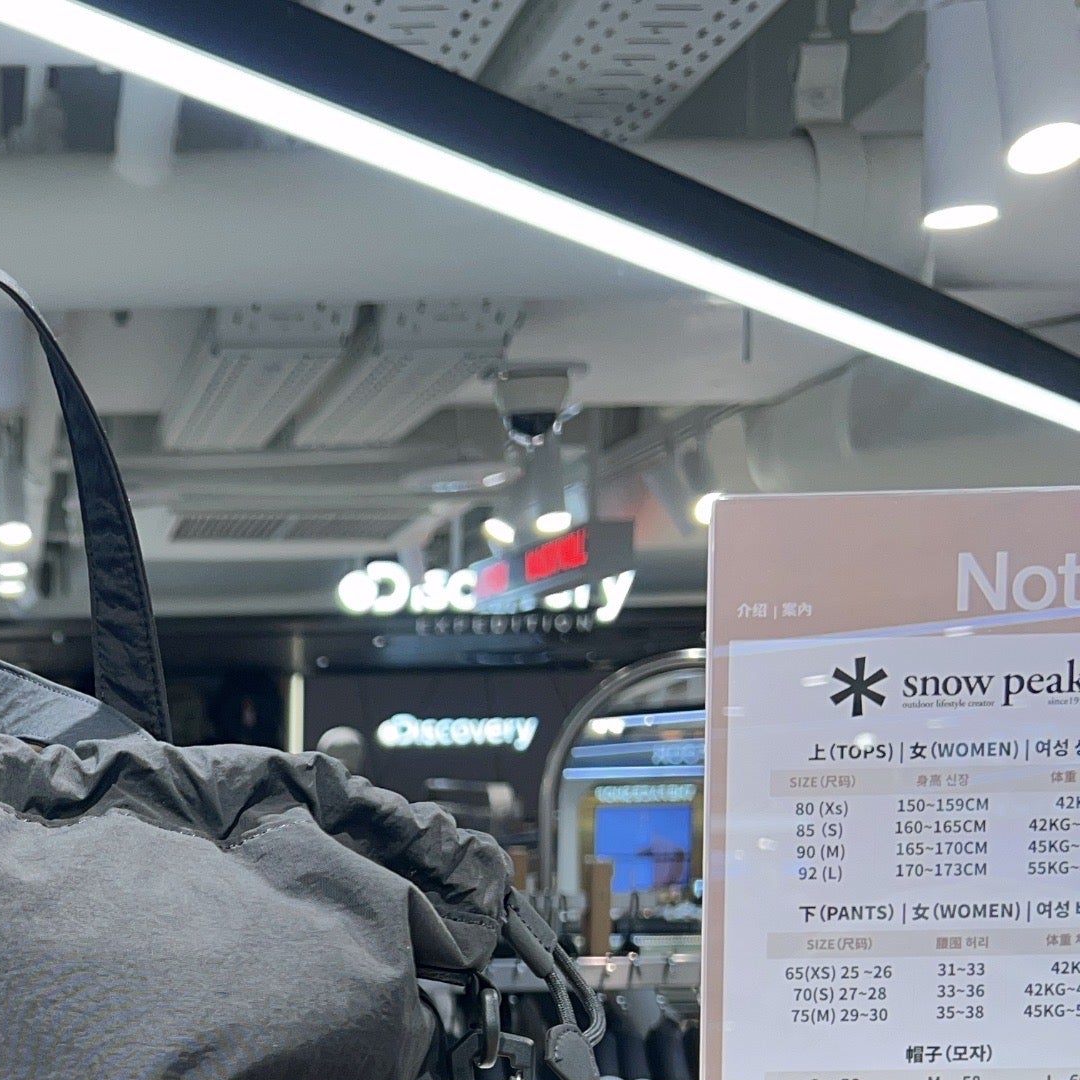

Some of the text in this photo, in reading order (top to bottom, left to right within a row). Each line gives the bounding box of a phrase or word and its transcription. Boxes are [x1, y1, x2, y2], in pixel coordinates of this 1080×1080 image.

[956, 551, 1080, 612] Not
[902, 658, 1080, 707] snow peak
[902, 699, 995, 710] outdoor lifestyle creator
[386, 713, 539, 751] Discovery
[909, 740, 1019, 760] 女(WOMEN)
[1035, 739, 1069, 757] 여성
[945, 774, 969, 787] 신장
[795, 802, 814, 816] 80
[819, 801, 849, 817] (Xs)
[897, 798, 989, 812] 150~159CM
[796, 824, 815, 837] 85
[822, 822, 843, 839] (S)
[895, 820, 986, 834] 160~165CM
[796, 846, 816, 859] 90
[821, 844, 845, 861] (M)
[896, 841, 988, 856] 165~170CM
[798, 867, 817, 880] 92
[822, 866, 842, 882] (L)
[895, 863, 987, 877] 170~173CM
[912, 901, 1020, 921] 女(WOMEN)
[1036, 900, 1070, 918] 여성
[966, 936, 989, 949] 허리
[785, 965, 836, 982] 65(XS)
[937, 963, 985, 976] 31~33
[793, 987, 834, 1003] 70(S)
[839, 987, 887, 1001] 27~28
[937, 985, 985, 998] 33~36
[791, 1008, 836, 1025] 75(M)
[840, 1008, 888, 1022] 29~30
[936, 1006, 984, 1019] 35~38
